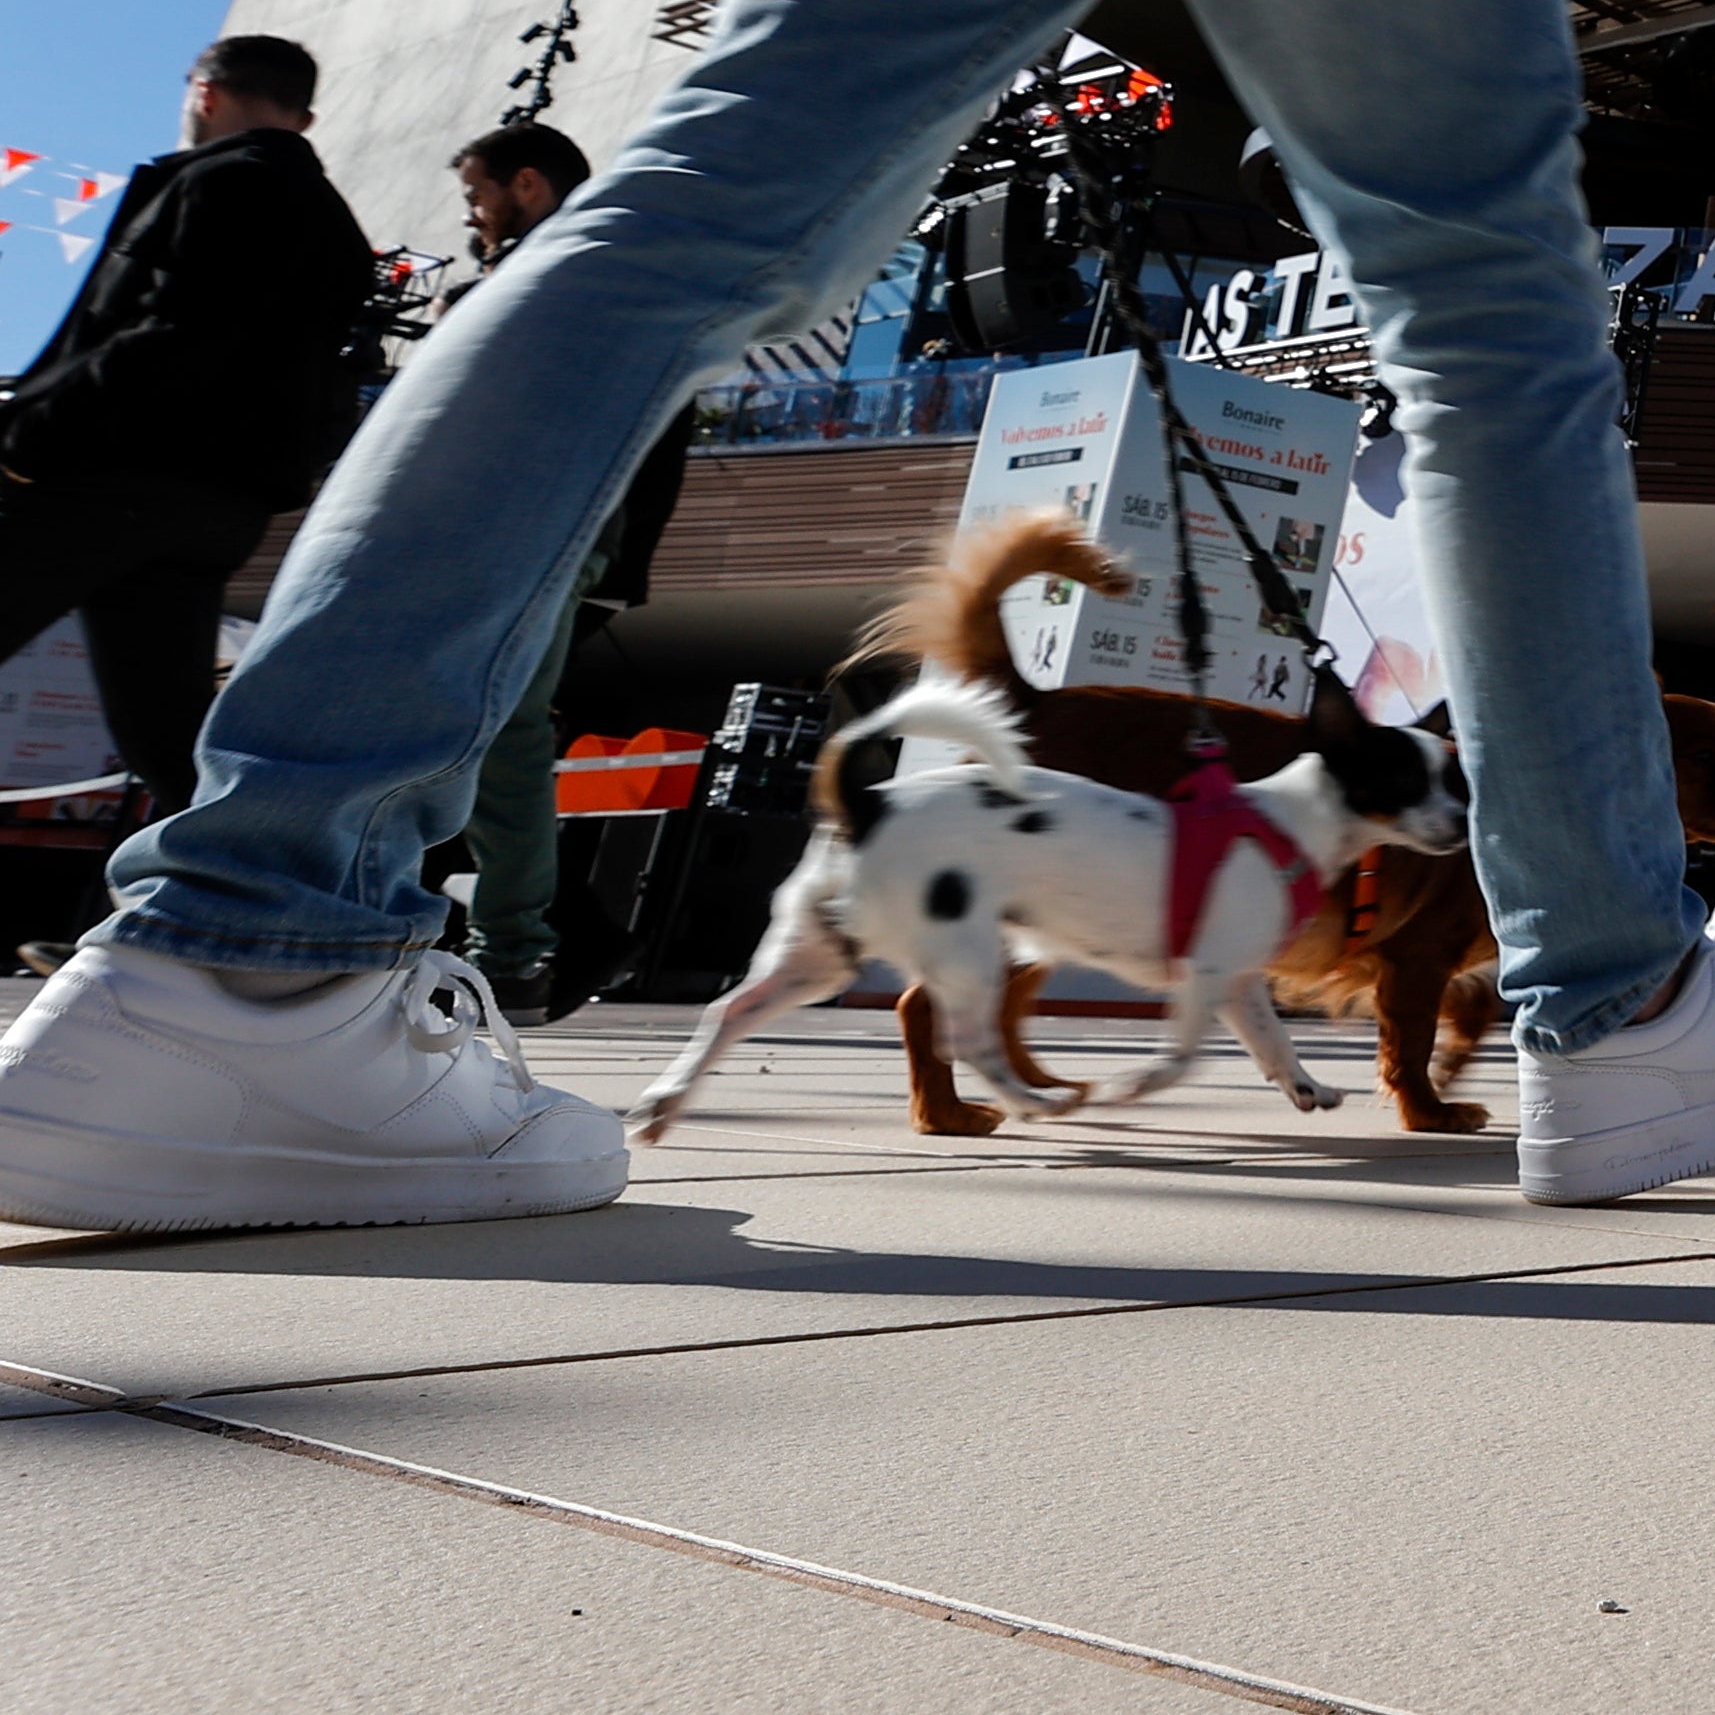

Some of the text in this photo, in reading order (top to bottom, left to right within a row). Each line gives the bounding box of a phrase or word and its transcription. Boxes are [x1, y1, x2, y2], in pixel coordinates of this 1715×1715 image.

[1221, 399, 1286, 432] Bonaire
[1269, 446, 1284, 465] a
[1286, 447, 1332, 476] latir
